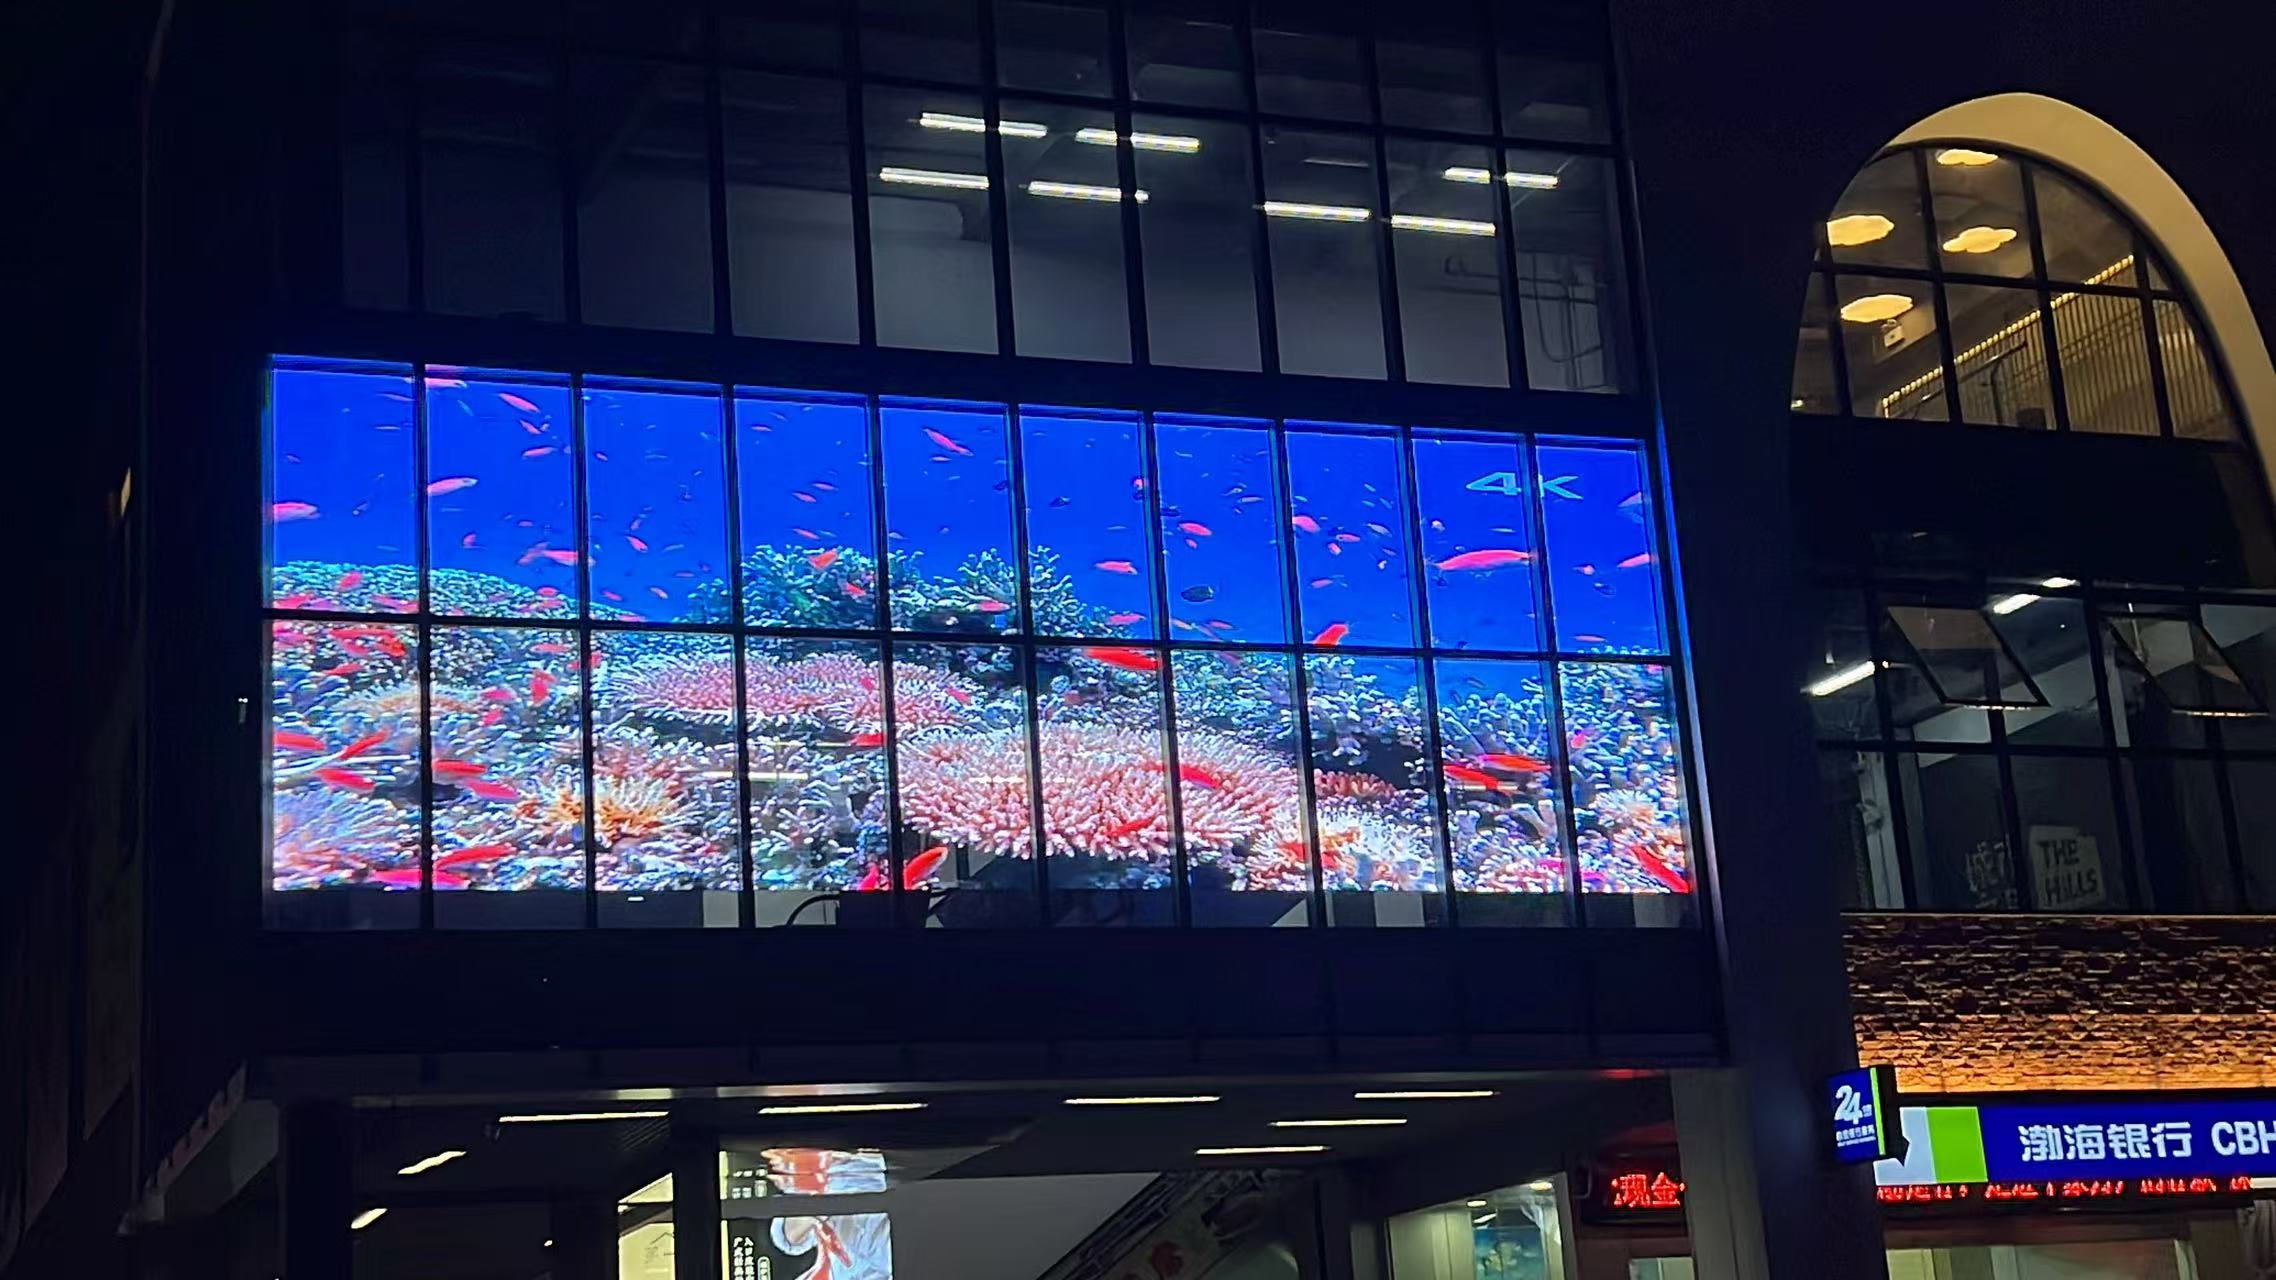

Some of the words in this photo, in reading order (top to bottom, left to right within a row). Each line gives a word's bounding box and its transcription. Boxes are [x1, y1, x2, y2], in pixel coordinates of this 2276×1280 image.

[1466, 472, 1583, 500] 4K
[2037, 839, 2080, 869] THE
[2045, 868, 2098, 906] HILLS
[1834, 1085, 1863, 1125] 24
[2018, 1121, 2193, 1162] 渤海银行
